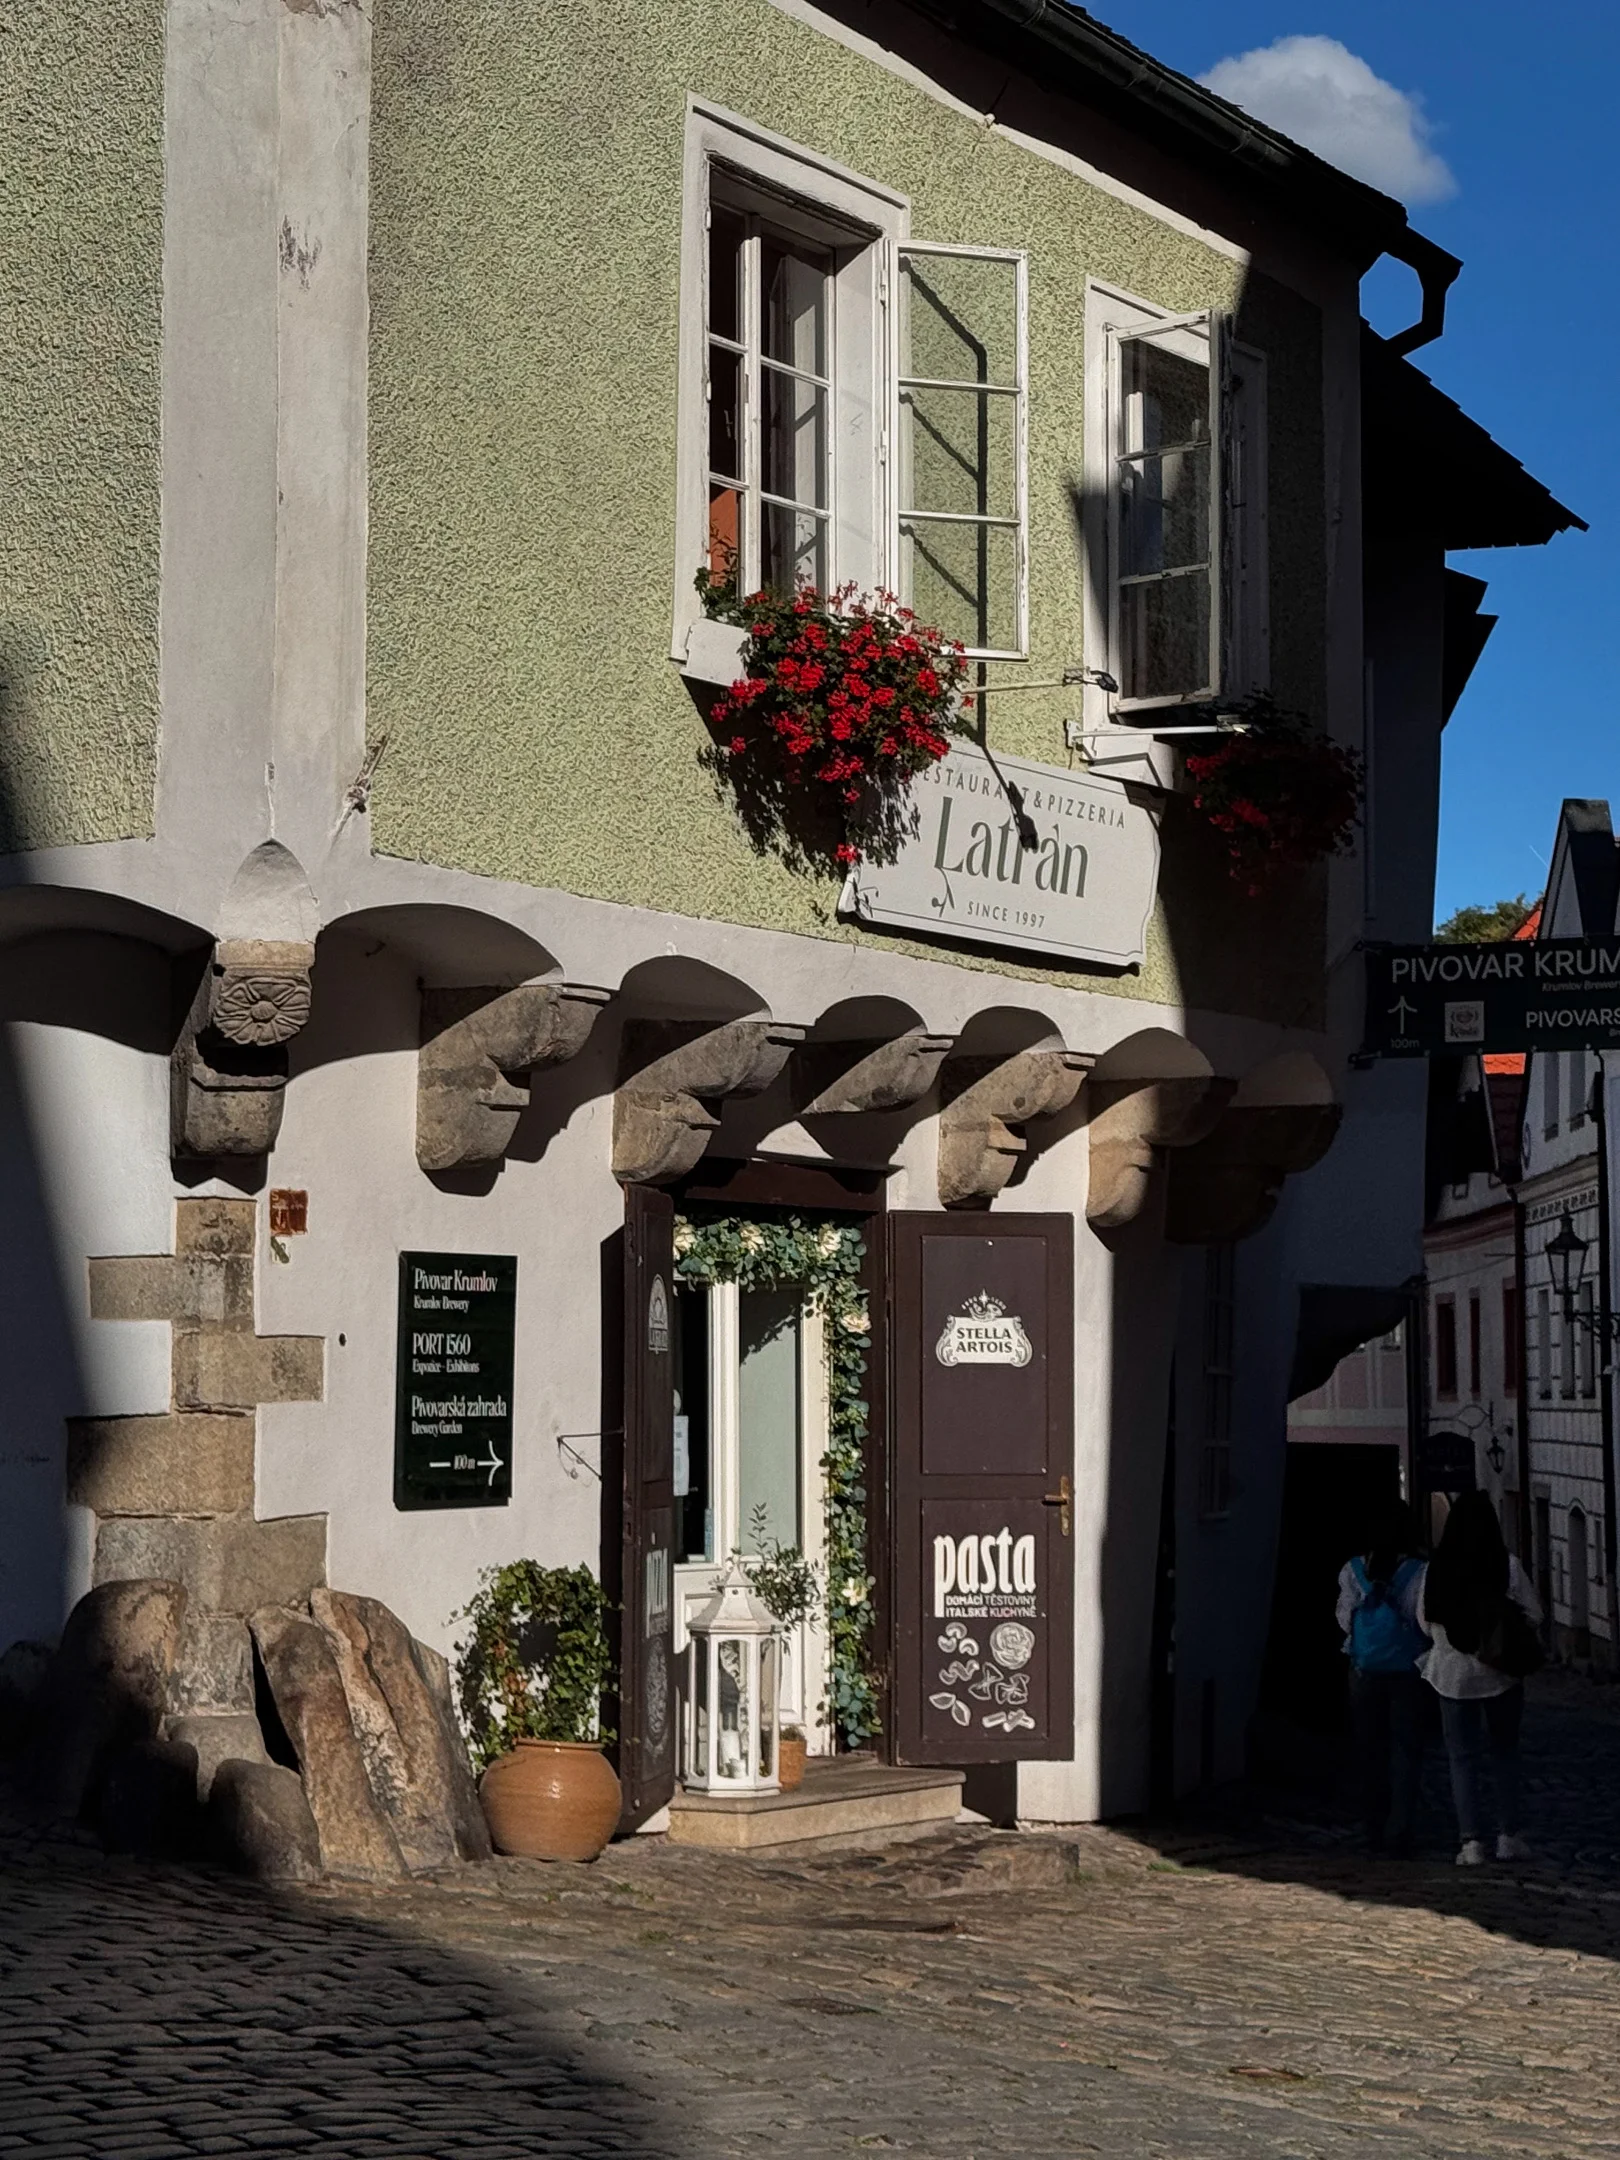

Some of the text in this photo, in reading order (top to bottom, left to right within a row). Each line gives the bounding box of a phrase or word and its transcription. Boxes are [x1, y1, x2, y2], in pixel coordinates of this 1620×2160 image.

[913, 765, 1125, 829] ESTAURAT & PIZZERIA
[967, 901, 1046, 929] SINCE 1997
[1392, 947, 1620, 984] PIVOVAR KRUM
[413, 1267, 499, 1292] Pivovar Krumlov
[412, 1332, 471, 1355] PORT 1560
[955, 1327, 1013, 1353] STELLA ARTOIS
[411, 1394, 507, 1418] Pivovarská zahrada
[933, 1526, 1037, 1618] pasta
[945, 1593, 1037, 1606] DOMÁCÍ TĚSTOVINY
[945, 1605, 1037, 1618] ITALSKÉ KUCHYNĚ
